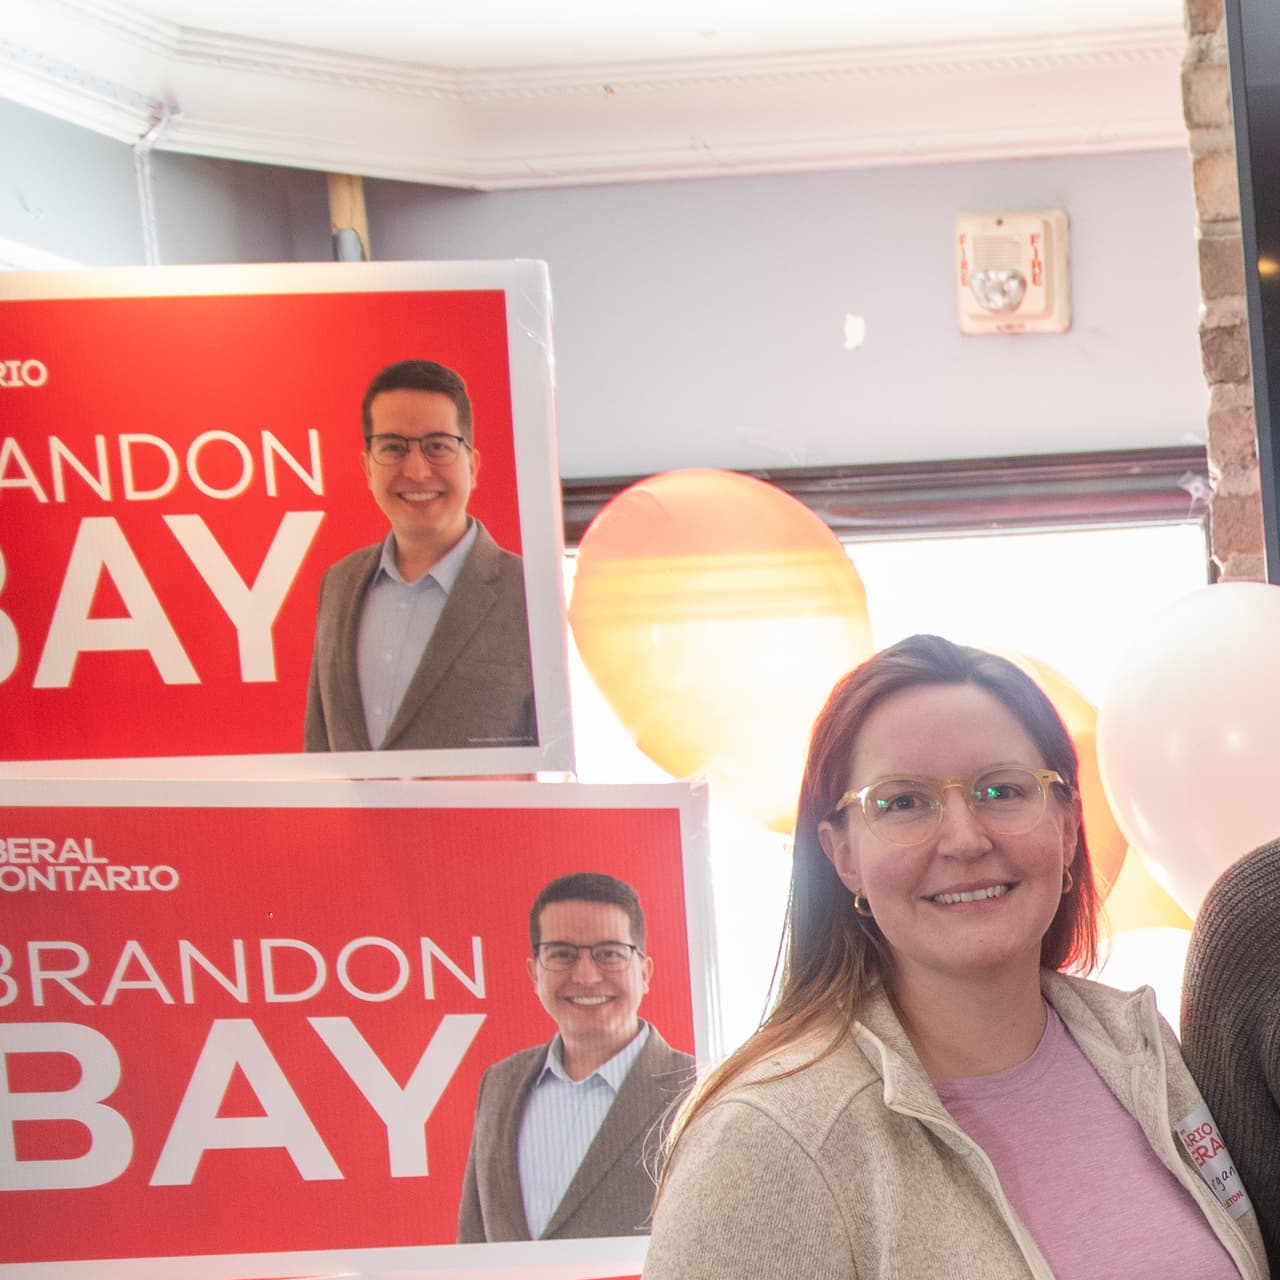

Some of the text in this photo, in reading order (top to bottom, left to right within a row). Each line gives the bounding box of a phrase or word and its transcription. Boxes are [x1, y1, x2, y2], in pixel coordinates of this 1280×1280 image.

[0, 511, 325, 689] AY
[0, 865, 179, 892] ONTARIO
[0, 1013, 488, 1191] BAY
